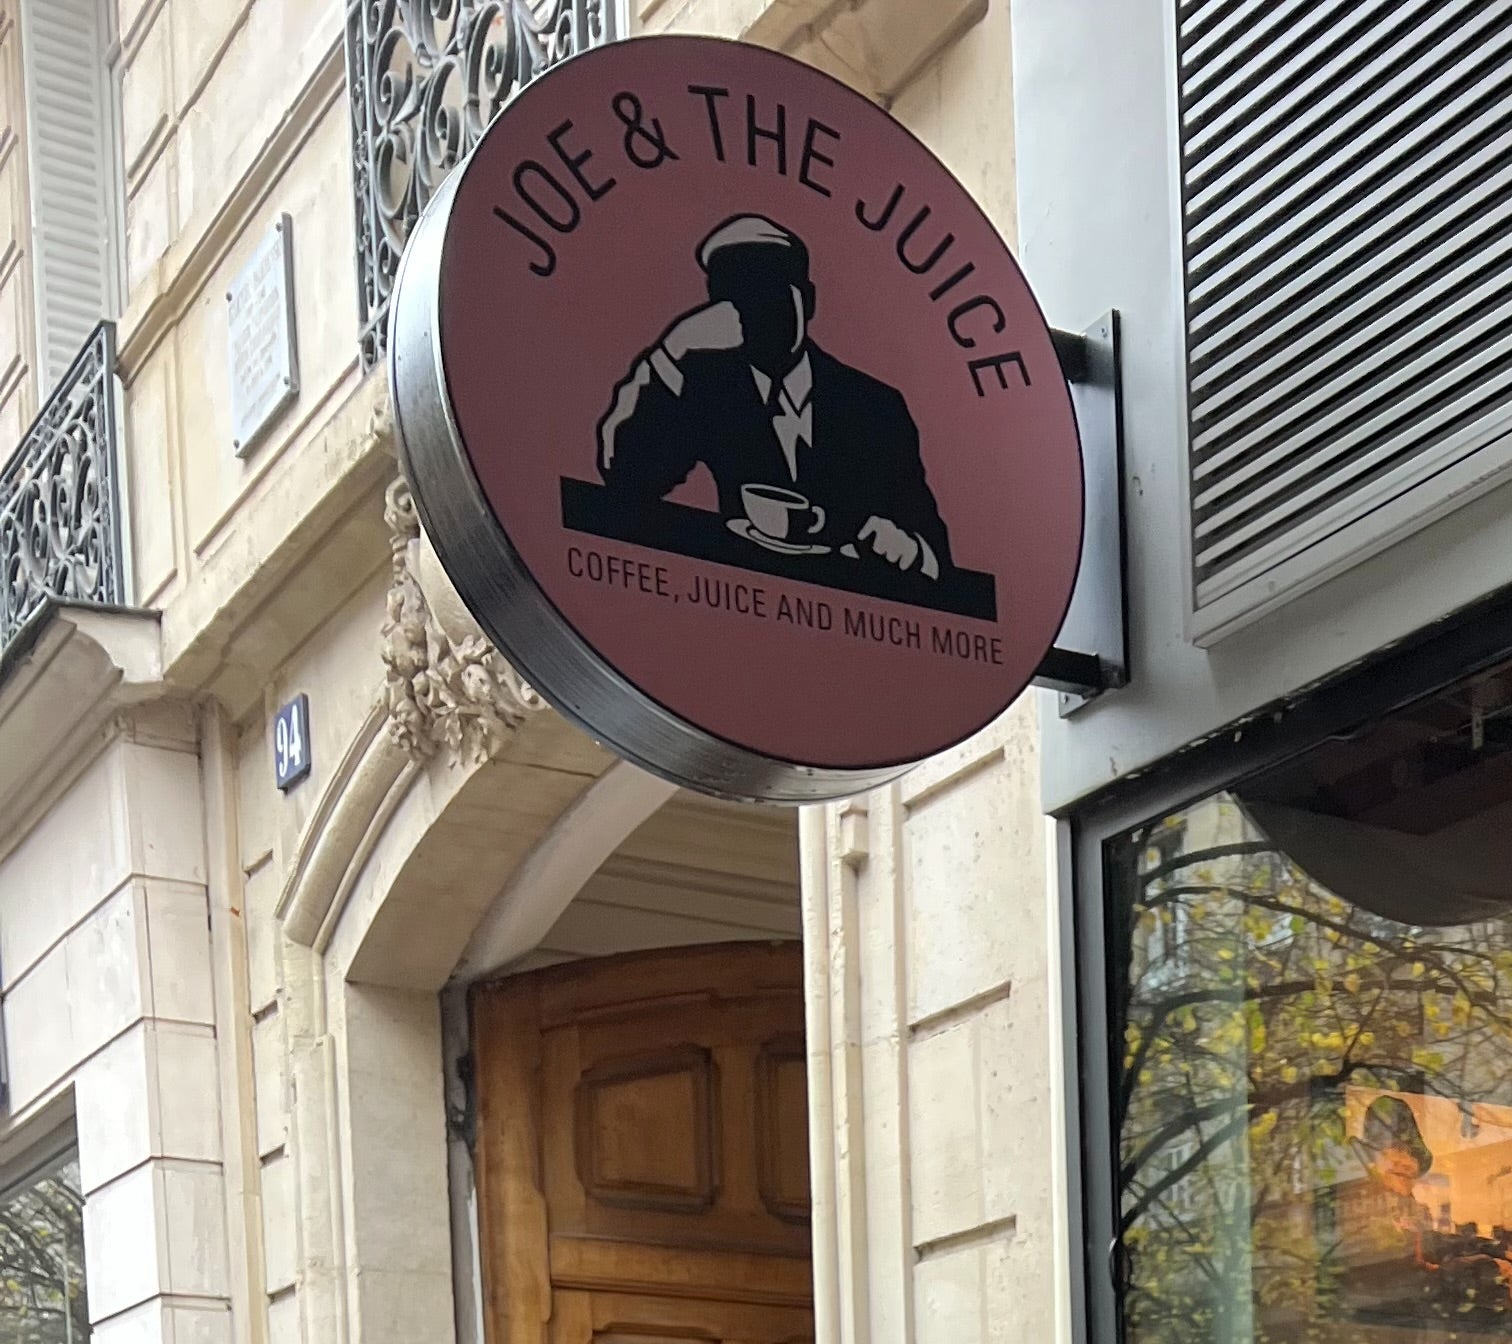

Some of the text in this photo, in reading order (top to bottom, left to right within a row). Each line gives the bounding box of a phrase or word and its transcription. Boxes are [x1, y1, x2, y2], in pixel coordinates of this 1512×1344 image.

[492, 84, 1031, 397] JOE & THE JUICE
[567, 546, 1004, 666] COFFEE, JUICE AND MUCH MORE
[276, 703, 302, 778] 94
